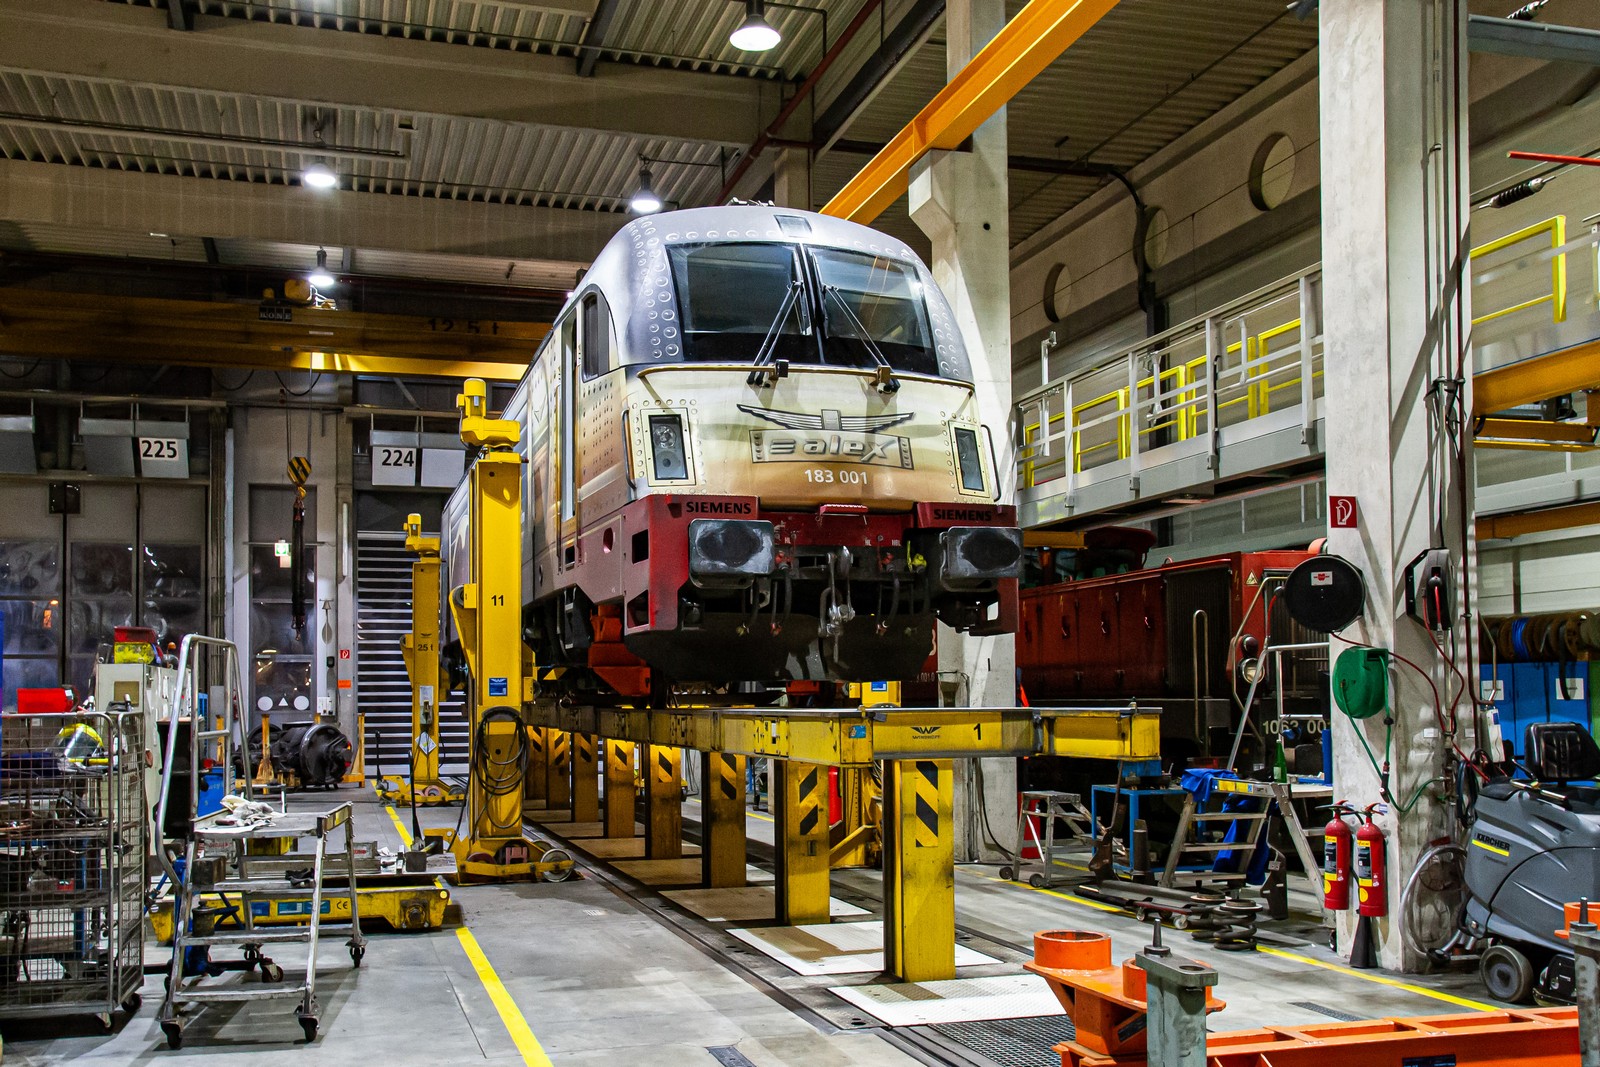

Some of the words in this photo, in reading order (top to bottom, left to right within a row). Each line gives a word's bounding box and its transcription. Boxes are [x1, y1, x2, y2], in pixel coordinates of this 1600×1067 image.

[141, 440, 177, 458] 225
[381, 449, 414, 467] 224
[804, 469, 834, 483] 183
[839, 470, 868, 484] 001
[686, 501, 752, 514] SIEMENS
[933, 508, 992, 521] SIEMENS
[491, 594, 504, 606] 11
[973, 723, 982, 741] 1
[1307, 719, 1332, 735] 00
